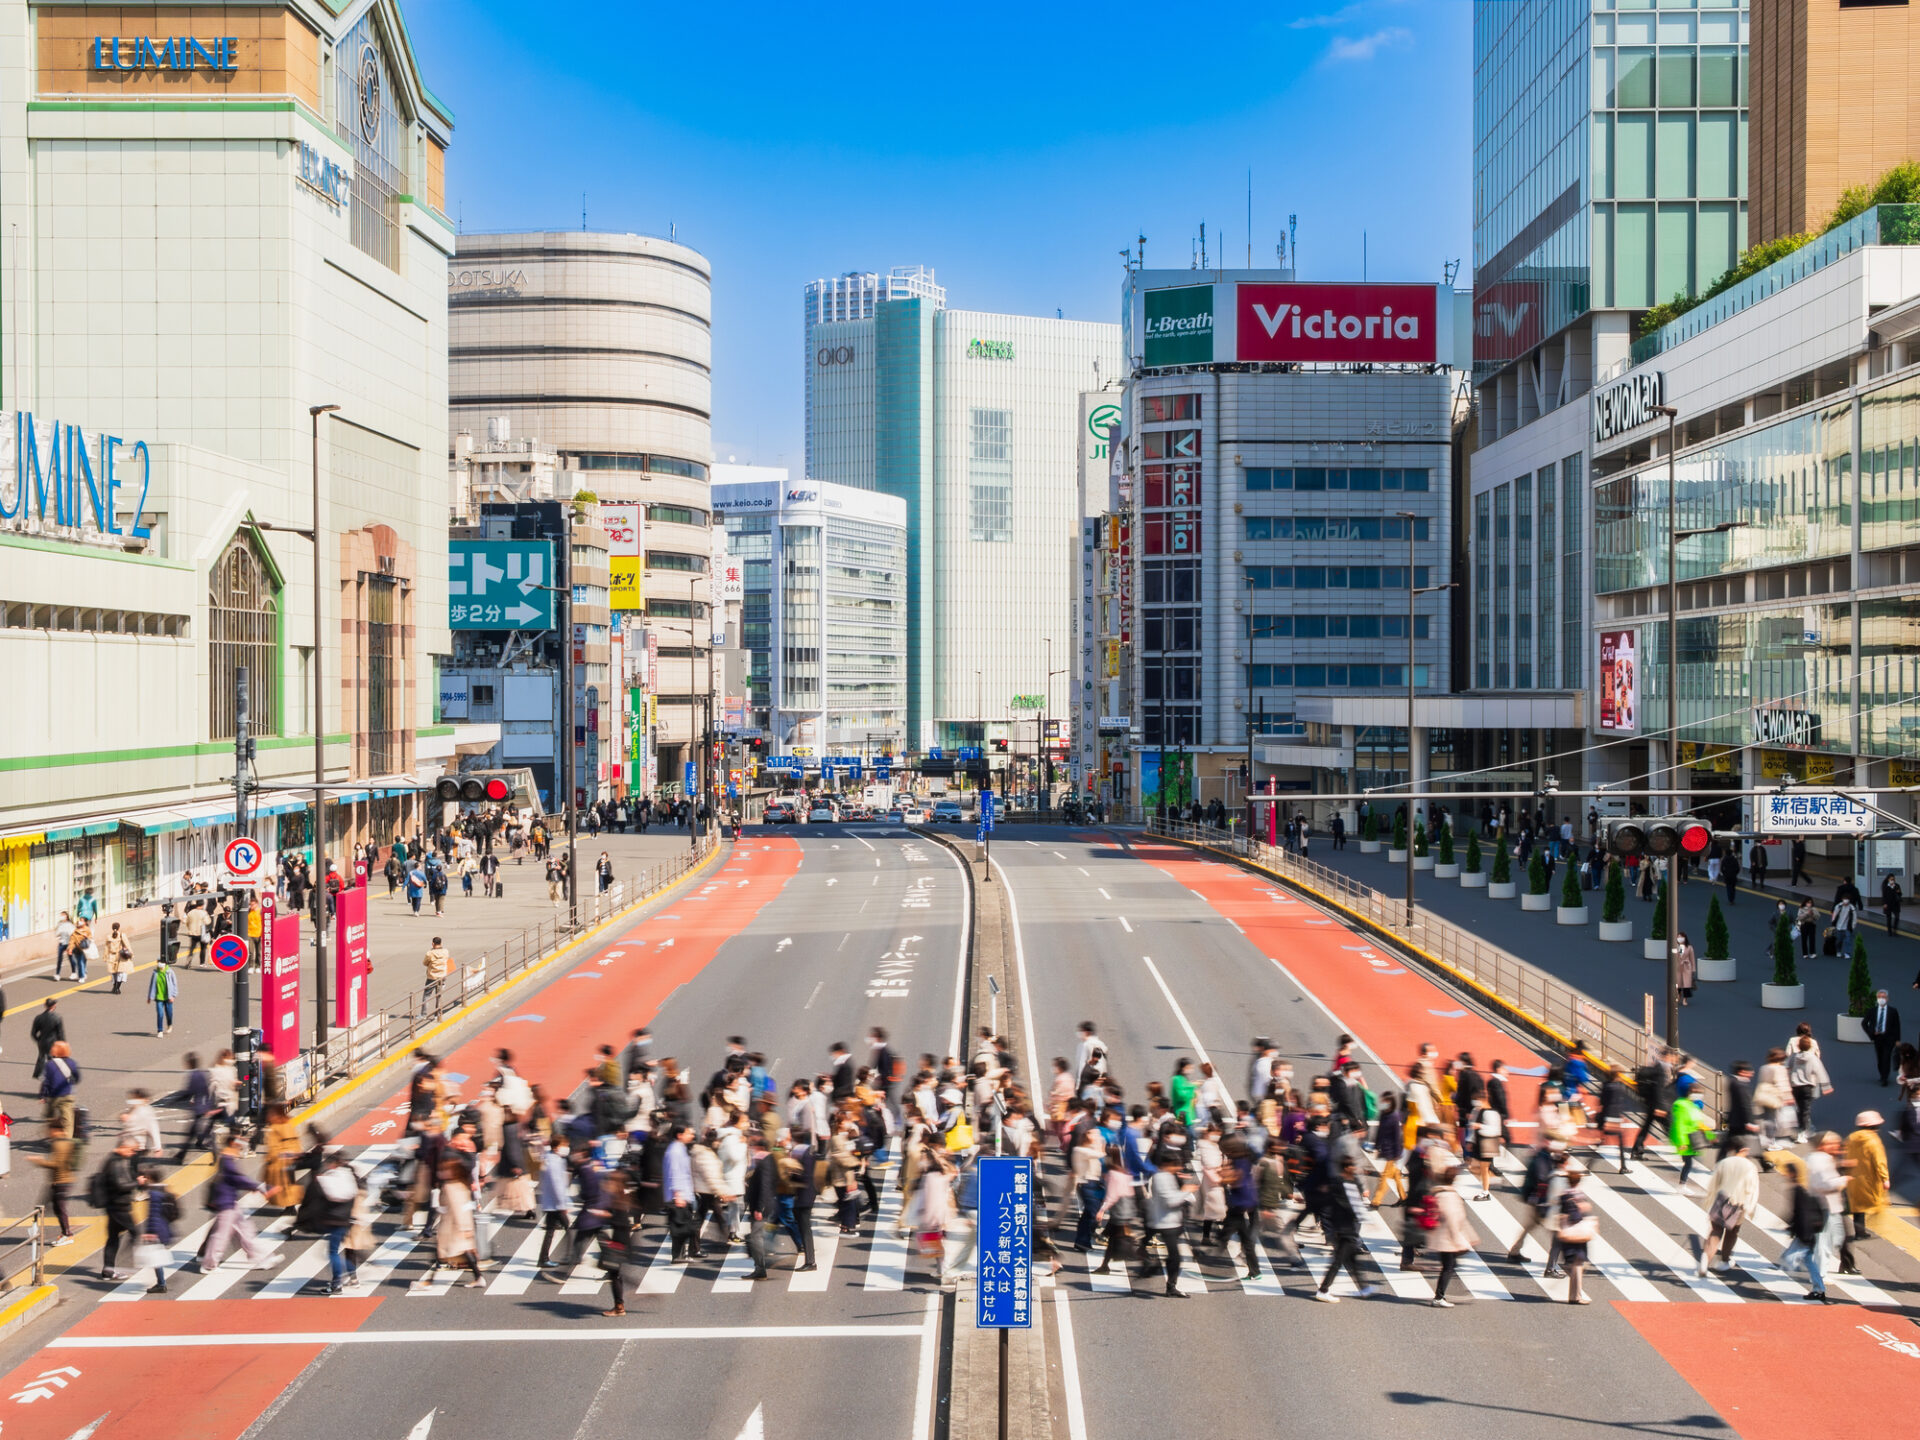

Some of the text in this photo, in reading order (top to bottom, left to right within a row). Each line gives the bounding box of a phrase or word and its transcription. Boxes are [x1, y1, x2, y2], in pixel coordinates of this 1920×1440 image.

[94, 36, 239, 70] LUMINE
[342, 168, 349, 207] 2
[1146, 312, 1213, 333] L-Breath
[1252, 303, 1419, 340] Victoria
[131, 440, 151, 539] 2
[713, 498, 773, 509] www.keio.co.jp
[726, 566, 740, 582] 集
[725, 584, 740, 592] 666
[451, 605, 502, 622] 歩2分
[1770, 796, 1866, 816] 新宿駅南口
[1772, 816, 1816, 828] Shinjuku
[1820, 816, 1840, 826] Sta.
[1856, 816, 1866, 826] S.
[998, 1192, 1012, 1293] バスタ新宿へは
[1014, 1164, 1028, 1322] 一般車・貸切バス・大型貨物車は
[982, 1250, 996, 1322] 入れません
